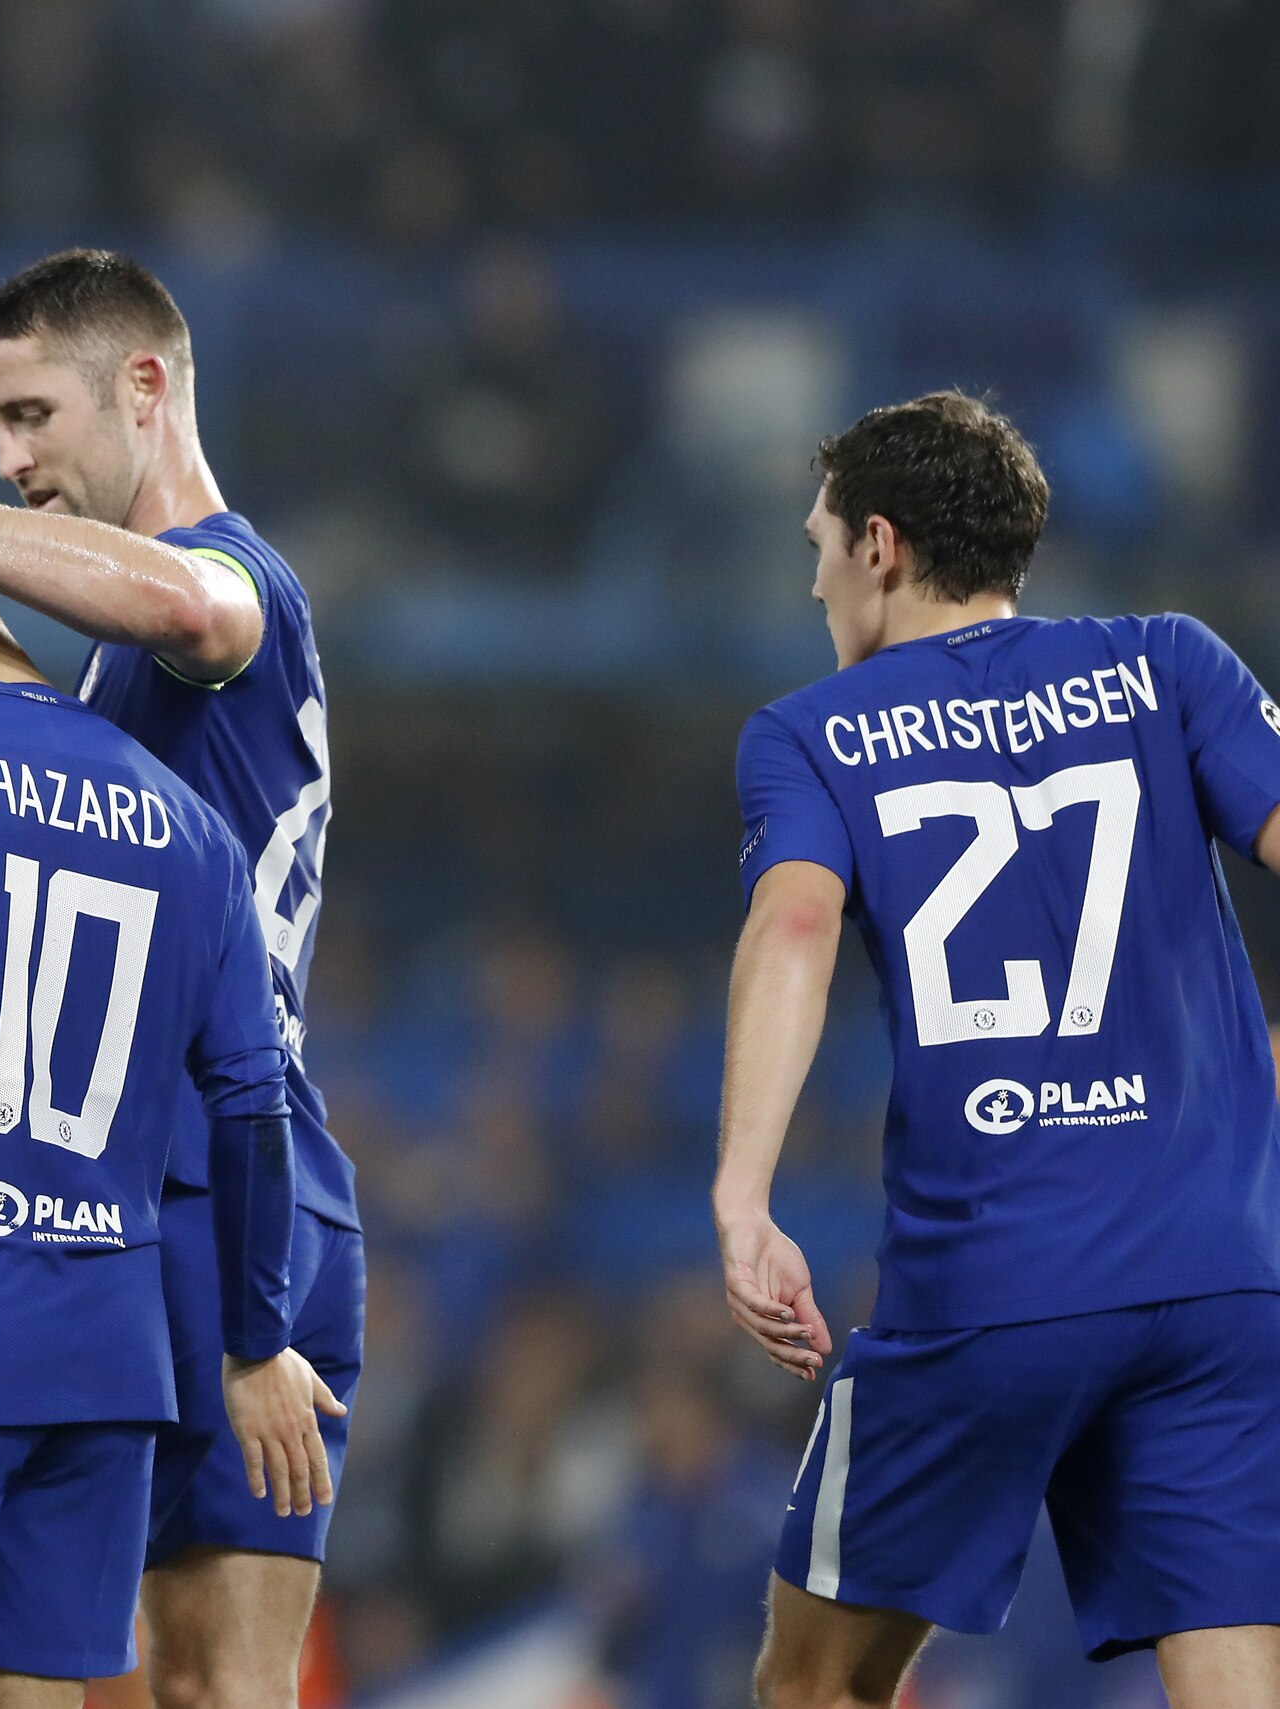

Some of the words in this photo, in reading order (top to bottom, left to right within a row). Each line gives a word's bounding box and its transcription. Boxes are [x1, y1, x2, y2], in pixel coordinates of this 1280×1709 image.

[981, 625, 992, 635] FC
[825, 655, 1158, 766] CHRISTENSEN
[874, 758, 1141, 1047] 27
[1039, 1074, 1147, 1113] PLAN
[1039, 1110, 1148, 1127] INTERNATIONAL
[33, 1194, 123, 1234] PLAN
[32, 1231, 126, 1249] INTERNATIONAL
